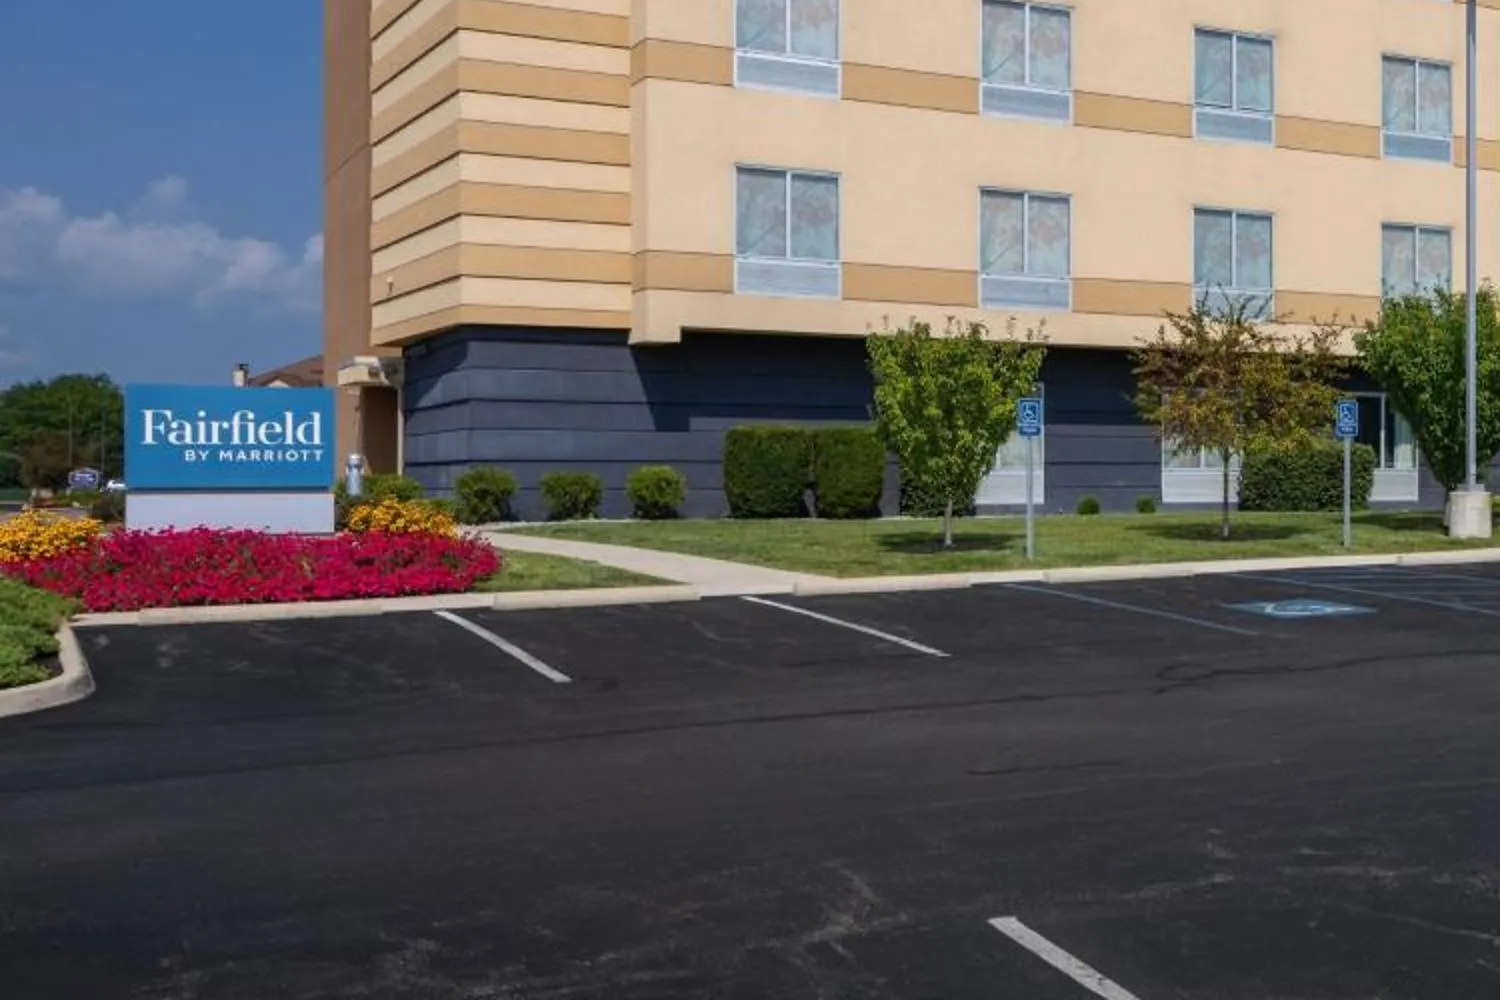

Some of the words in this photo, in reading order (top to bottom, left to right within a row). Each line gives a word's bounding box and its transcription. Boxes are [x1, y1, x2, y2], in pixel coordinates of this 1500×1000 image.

[140, 409, 325, 446] Fairfield
[185, 450, 209, 462] BY
[219, 450, 324, 462] MARRIOTT
